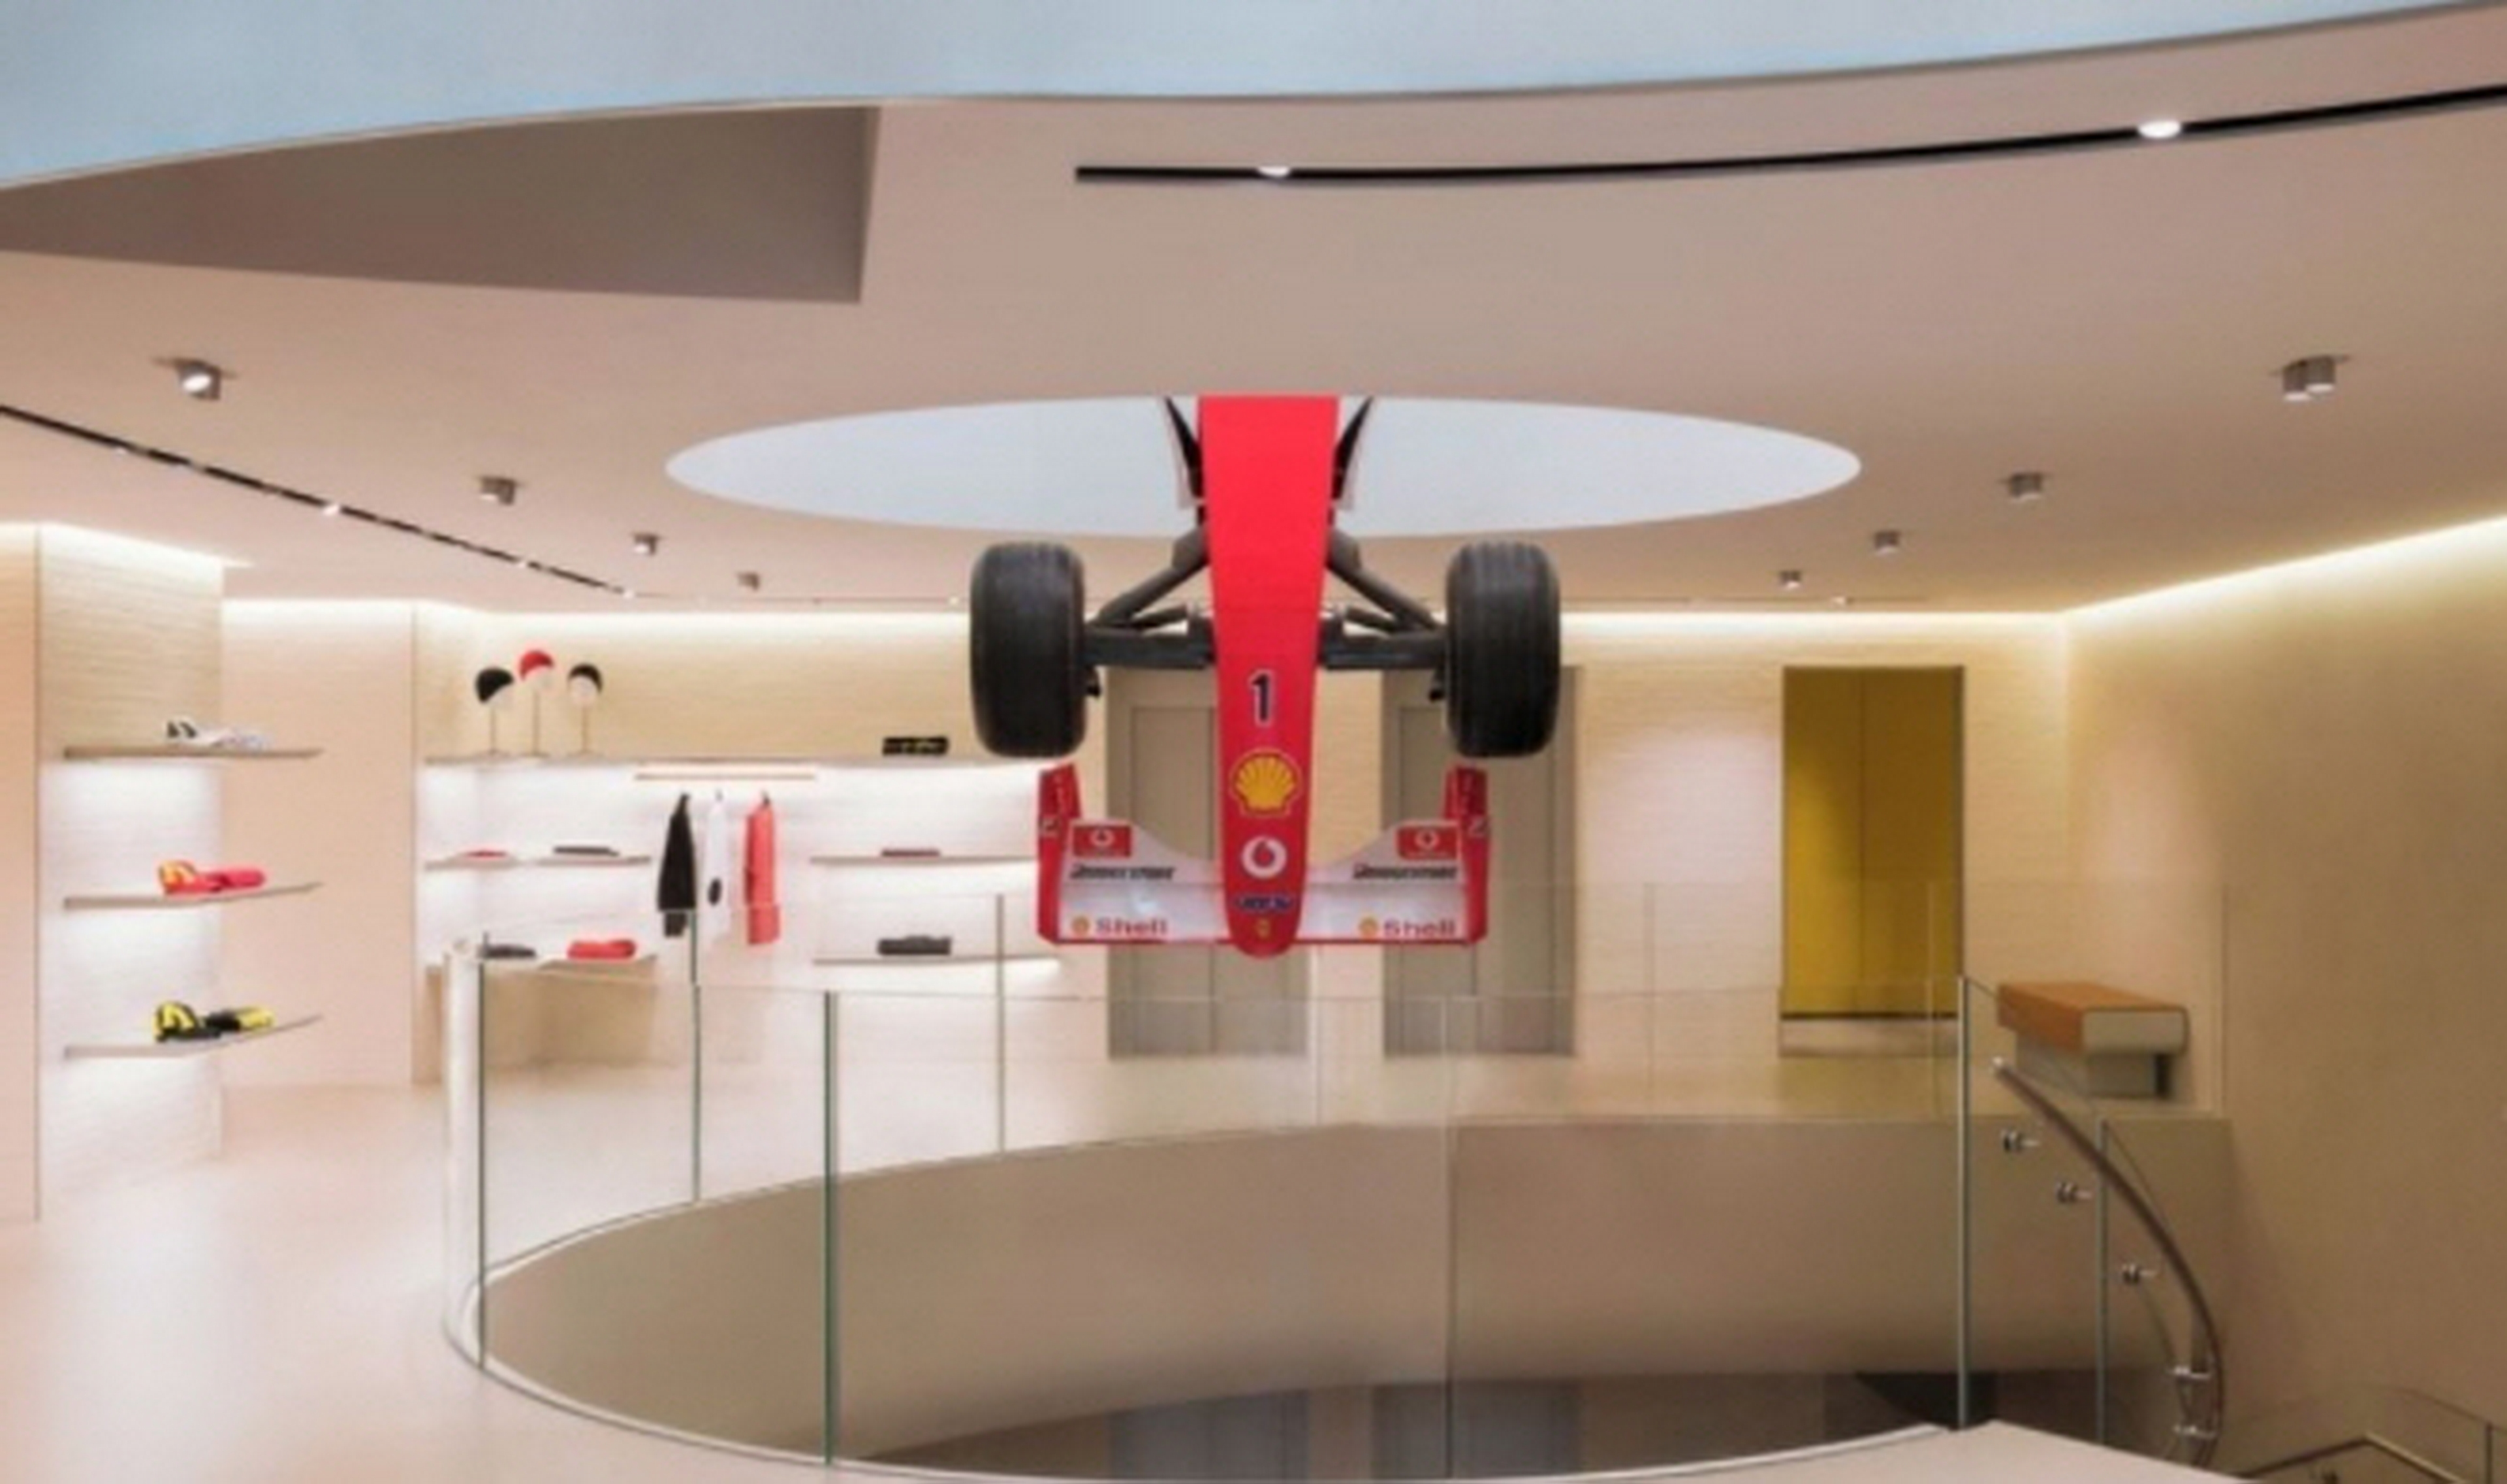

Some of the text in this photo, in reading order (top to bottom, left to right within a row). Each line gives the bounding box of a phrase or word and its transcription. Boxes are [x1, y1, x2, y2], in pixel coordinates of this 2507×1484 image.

[1252, 670, 1272, 723] 1
[1096, 918, 1167, 934] Shell
[1383, 919, 1455, 936] Shell
